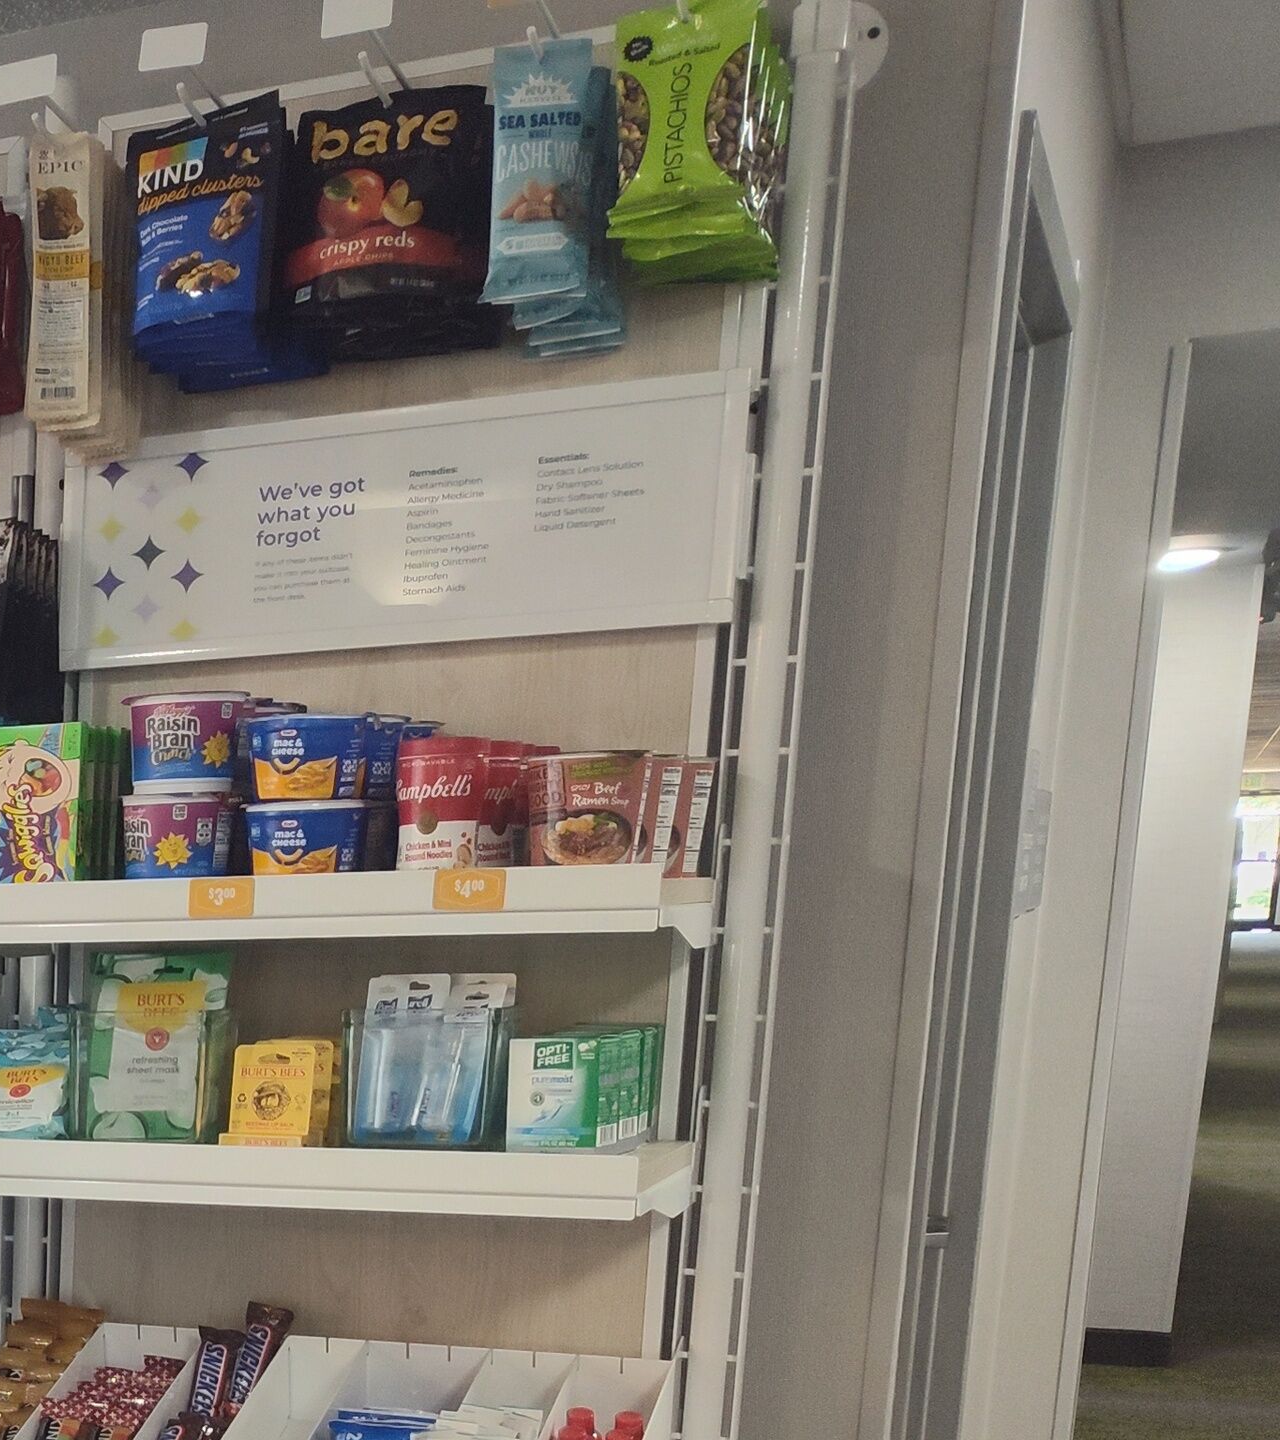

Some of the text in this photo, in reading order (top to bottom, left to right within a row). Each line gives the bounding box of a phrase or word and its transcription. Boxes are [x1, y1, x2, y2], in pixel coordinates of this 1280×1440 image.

[498, 111, 581, 131] SEA SALTED
[663, 62, 693, 185] PISTACHIOS
[310, 109, 459, 164] bare
[38, 160, 83, 174] EPIC
[496, 140, 580, 183] CASHEWS
[137, 158, 205, 199] KIND
[137, 173, 264, 216] dipped clusters
[151, 214, 188, 230] Chocolate
[319, 230, 416, 260] crispy reds
[537, 452, 590, 465] Essentials:
[408, 466, 458, 478] Remedies:
[259, 477, 365, 502] We've got
[408, 478, 484, 491] Acetaminophen
[407, 490, 485, 504] Allergy Medicine
[257, 503, 355, 525] what you
[406, 508, 439, 518] Aspirin
[534, 508, 561, 518] Hand
[406, 520, 453, 532] Bandages
[256, 526, 321, 548] forgot
[405, 542, 489, 557] Feminine Hygiene
[404, 556, 487, 570] Healing Ointment
[403, 572, 448, 584] Ibuprofen
[402, 584, 466, 597] Stomach Aids
[146, 716, 198, 737] Raisin
[151, 732, 193, 749] Bran
[273, 738, 303, 748] mac &
[593, 781, 623, 796] Beef
[572, 794, 609, 808] Ramen
[274, 828, 305, 838] mac &
[126, 835, 145, 850] ran
[405, 840, 430, 852] Chicken
[426, 849, 453, 860] Noodles
[137, 992, 185, 1007] BURT'S
[536, 1043, 570, 1058] OPTI-
[131, 1055, 179, 1067] refreshing
[536, 1053, 571, 1067] FREE
[126, 1065, 180, 1075] sheet mask
[241, 1066, 307, 1078] BURT'S BEES
[531, 1074, 574, 1085] puremoist
[191, 1341, 227, 1417] SNICKERS
